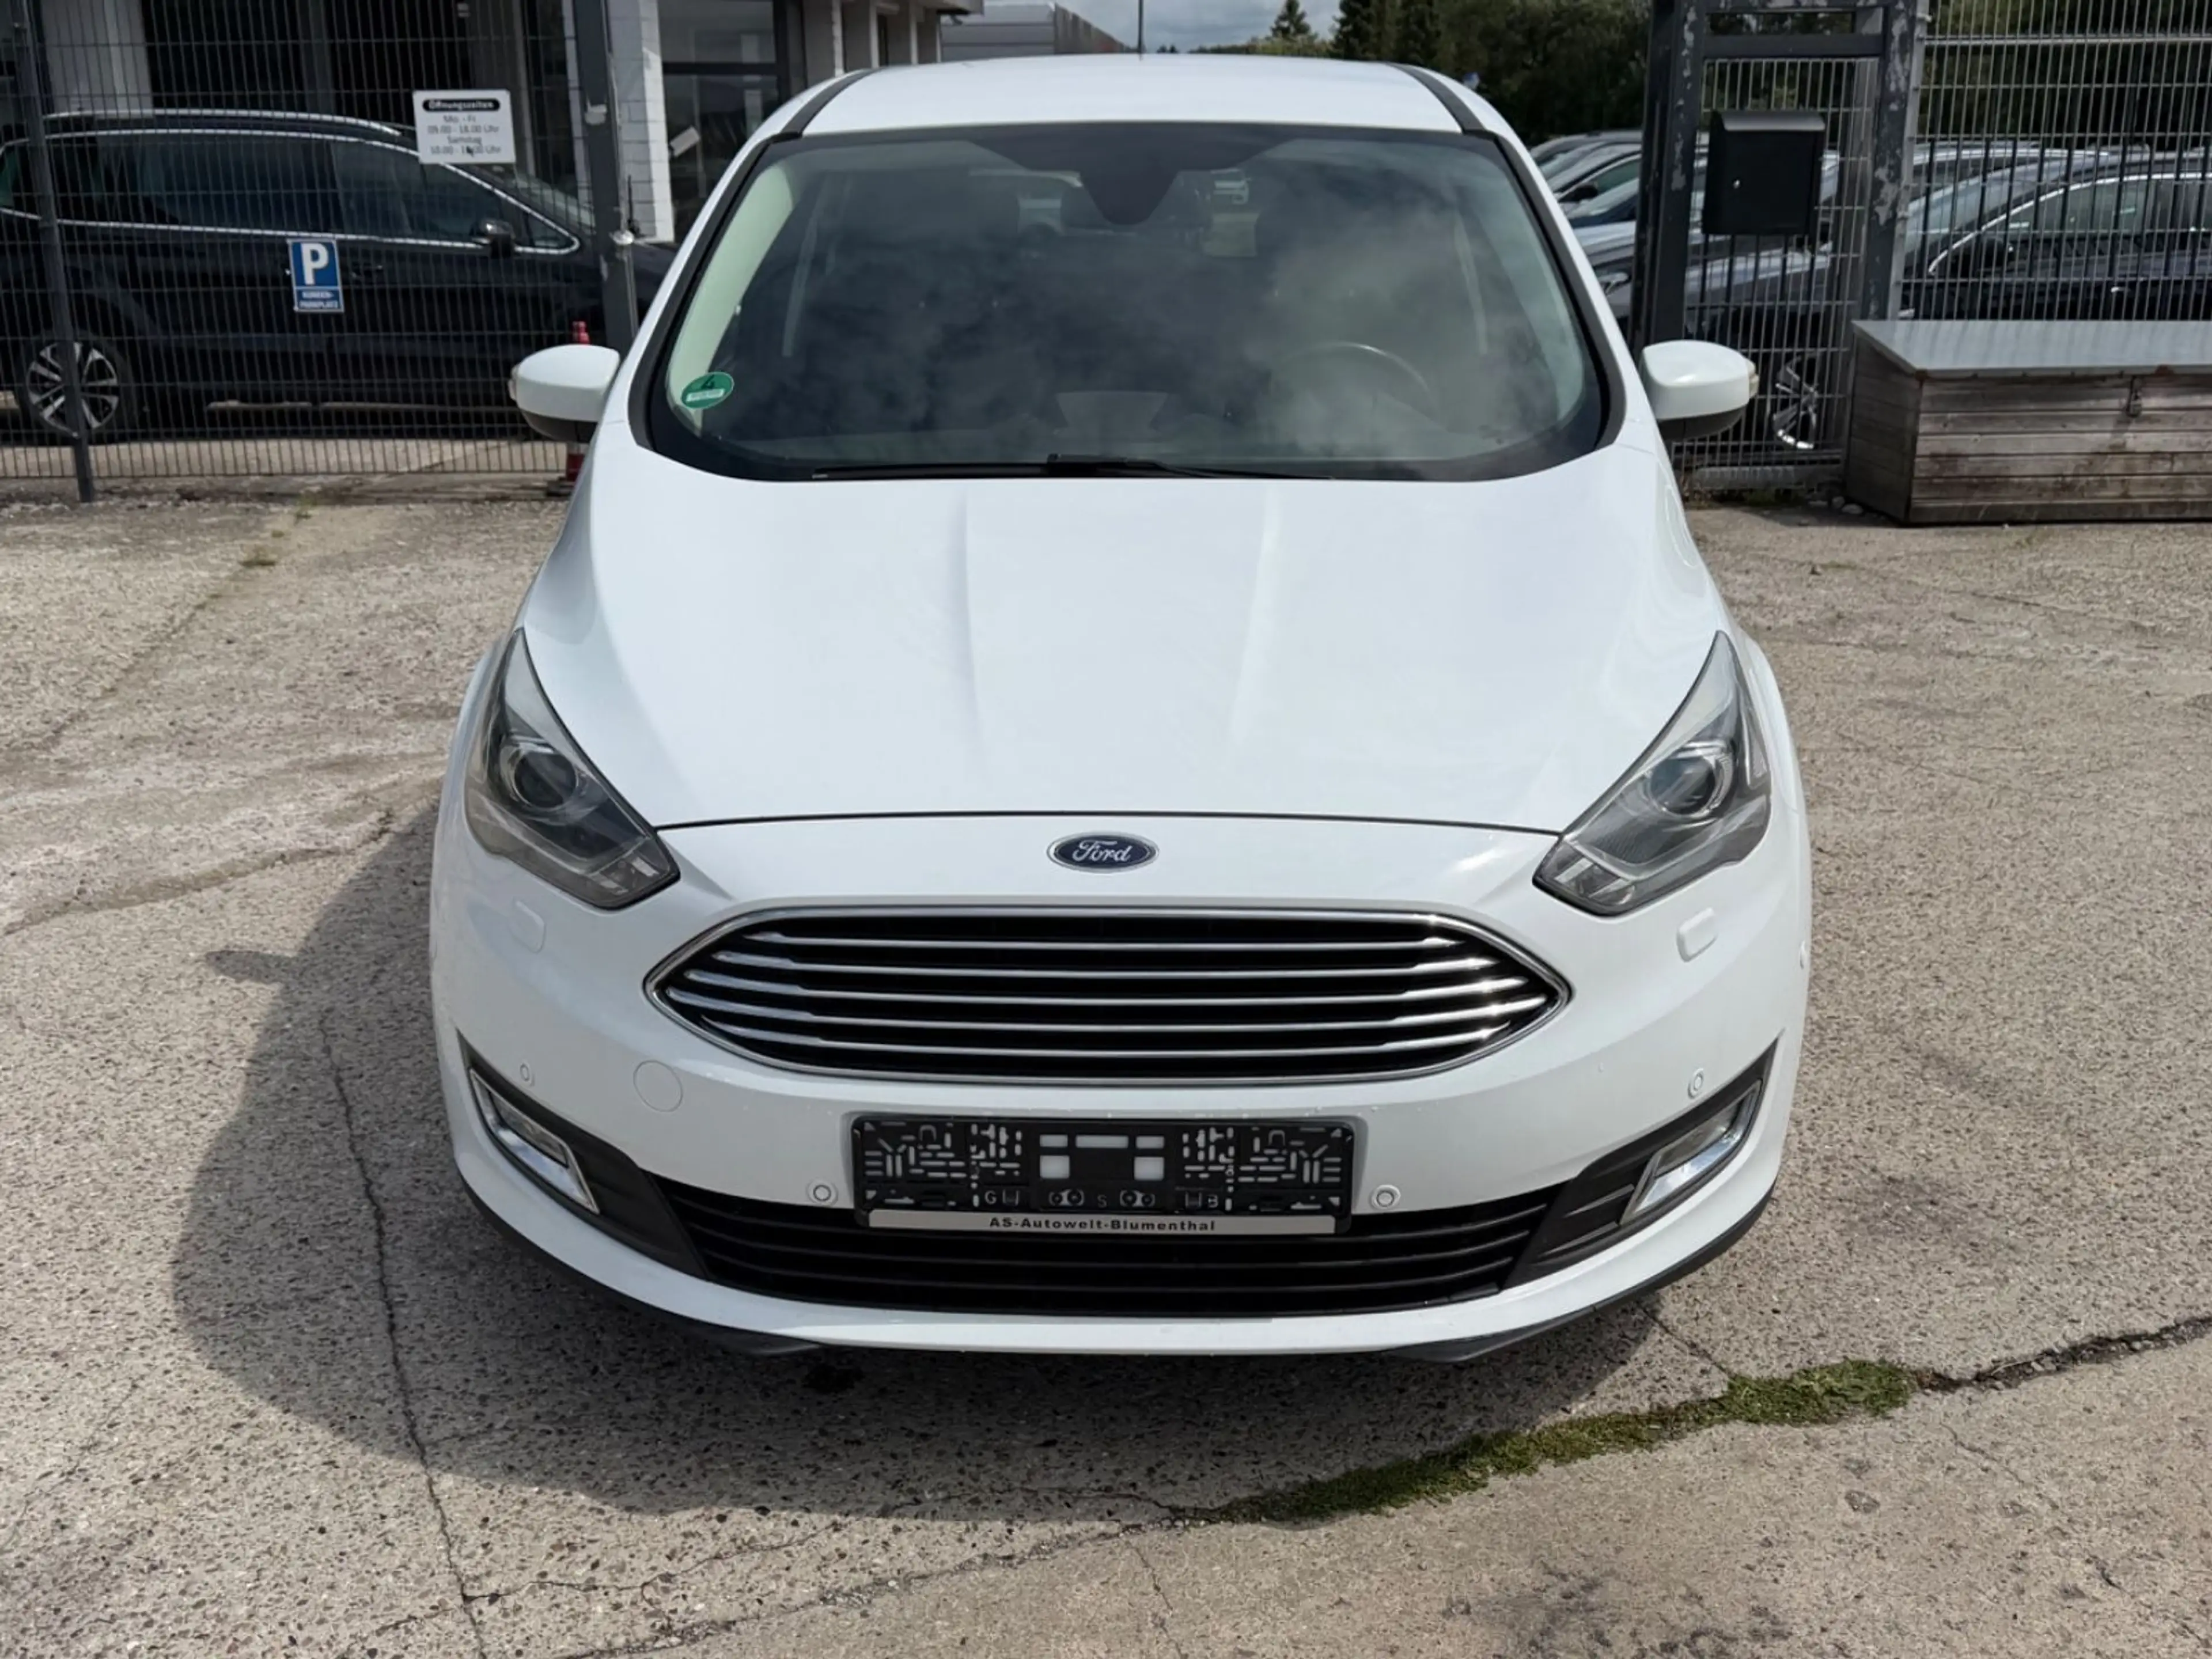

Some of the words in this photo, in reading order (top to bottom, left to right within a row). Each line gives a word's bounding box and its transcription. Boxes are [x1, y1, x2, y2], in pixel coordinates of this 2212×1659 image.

[484, 124, 500, 133] Uhr
[447, 135, 483, 146] Samstag
[485, 145, 502, 154] Uhr
[301, 243, 329, 285] P
[1072, 840, 1132, 862] Ford
[989, 1216, 1215, 1230] AS-Autowelt-Blumenthal
